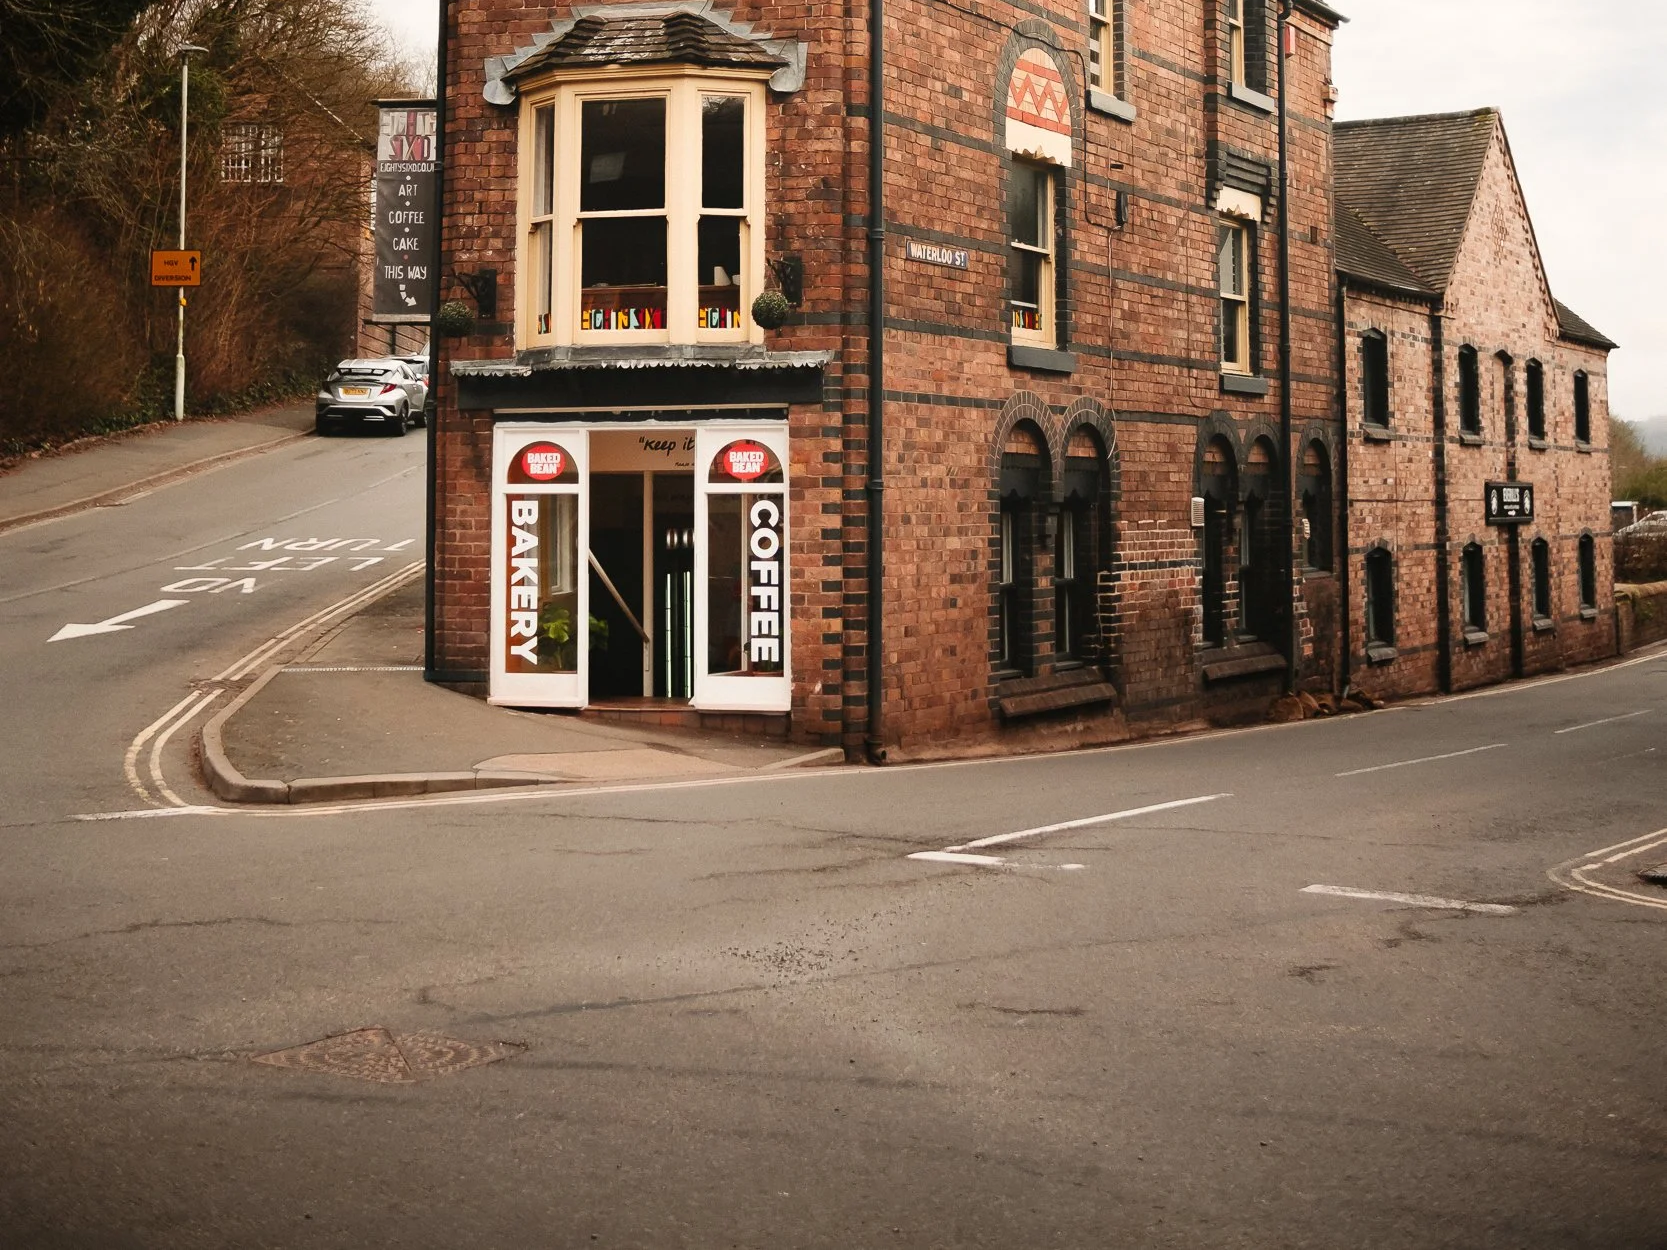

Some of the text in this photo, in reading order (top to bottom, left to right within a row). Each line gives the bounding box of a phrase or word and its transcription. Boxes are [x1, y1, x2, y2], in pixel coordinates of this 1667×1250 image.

[398, 184, 418, 197] ART
[388, 211, 425, 224] COFFEE
[392, 237, 420, 251] CAKE
[910, 242, 953, 264] WATERLOO
[154, 274, 192, 282] DIVERSION
[384, 265, 427, 280] THIS WAY
[527, 452, 561, 464] BAKED
[729, 451, 765, 463] BAKED
[236, 537, 416, 551] TURN
[173, 556, 385, 571] LEFT
[510, 500, 539, 666] BAKERY
[750, 500, 780, 662] COFFEE
